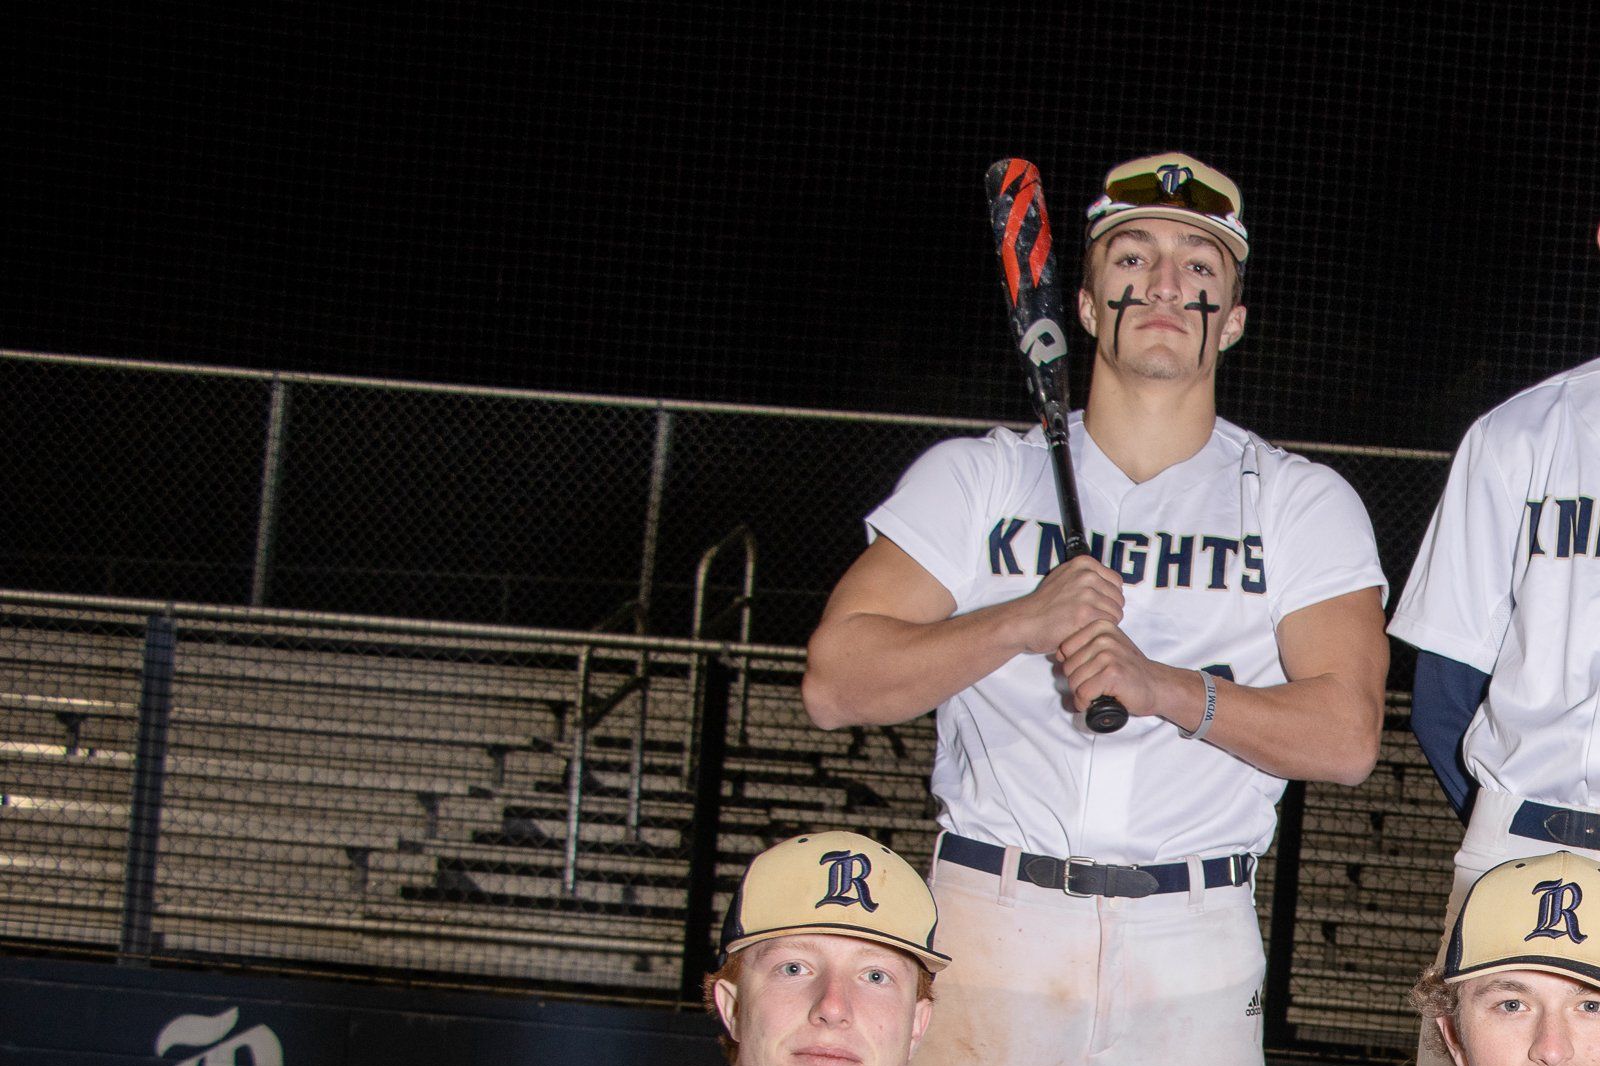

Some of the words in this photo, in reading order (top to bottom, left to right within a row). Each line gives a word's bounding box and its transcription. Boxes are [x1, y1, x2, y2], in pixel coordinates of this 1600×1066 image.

[1205, 695, 1216, 721] WDM
[815, 849, 879, 913] R
[1524, 878, 1588, 944] R
